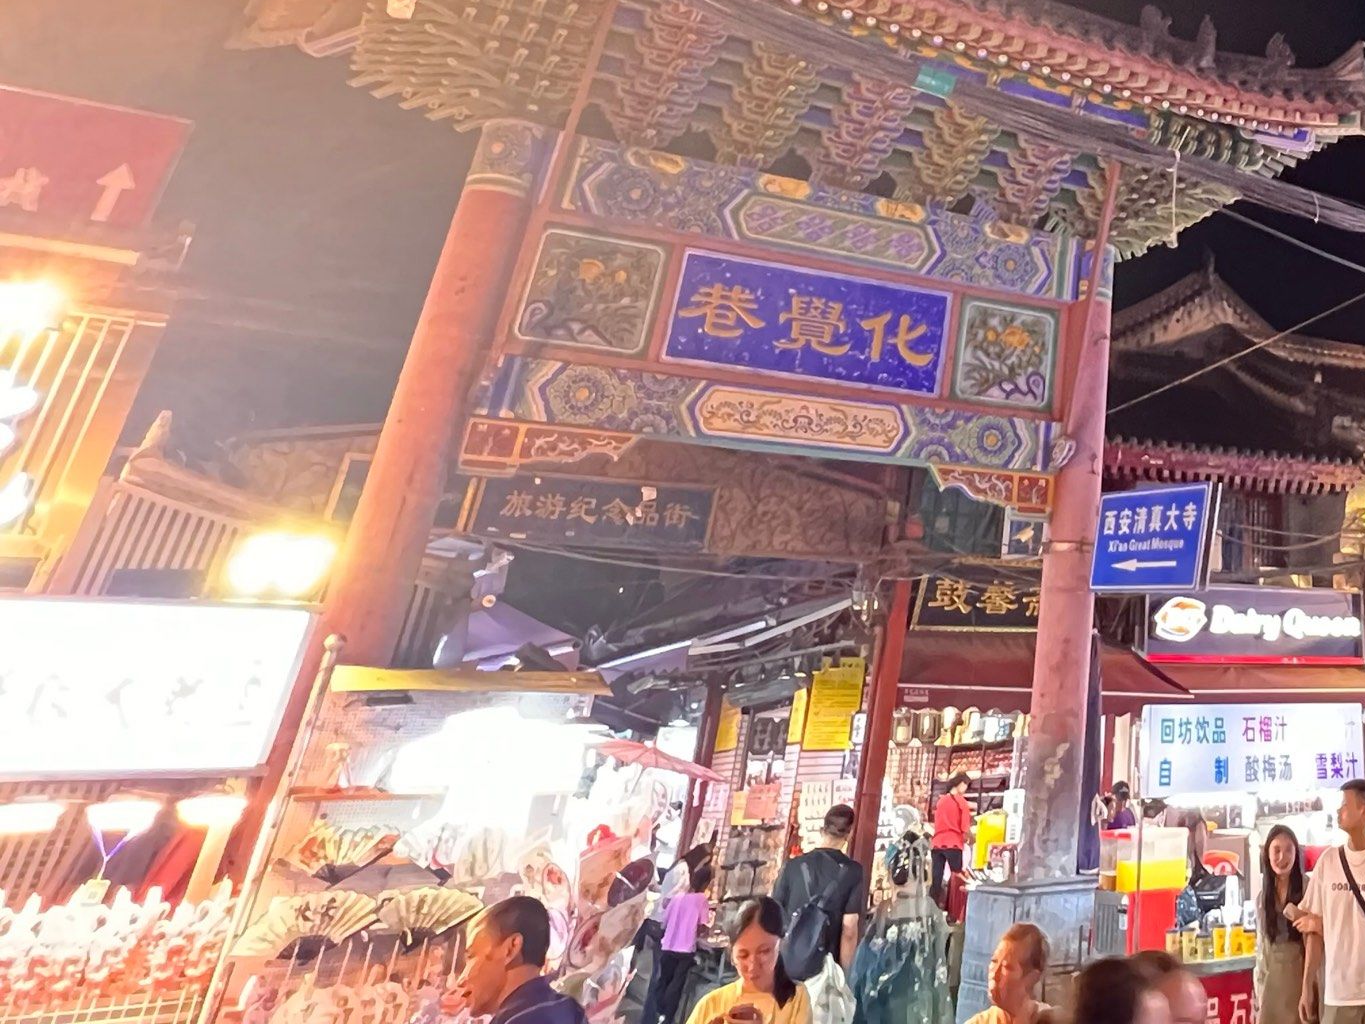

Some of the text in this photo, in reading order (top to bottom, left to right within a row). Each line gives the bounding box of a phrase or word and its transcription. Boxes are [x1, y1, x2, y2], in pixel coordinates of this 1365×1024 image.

[500, 489, 699, 527] 旅游纪念品街
[1103, 501, 1197, 535] 西安清真大寺
[1128, 538, 1150, 551] Great
[1151, 537, 1184, 551] Mosque
[1210, 604, 1281, 642] Dairy
[1282, 607, 1362, 640] Queen
[1160, 715, 1288, 745] 回坊饮品 石榴汁
[1244, 754, 1293, 783] 酸梅汤
[1315, 752, 1358, 780] 雪梨汁
